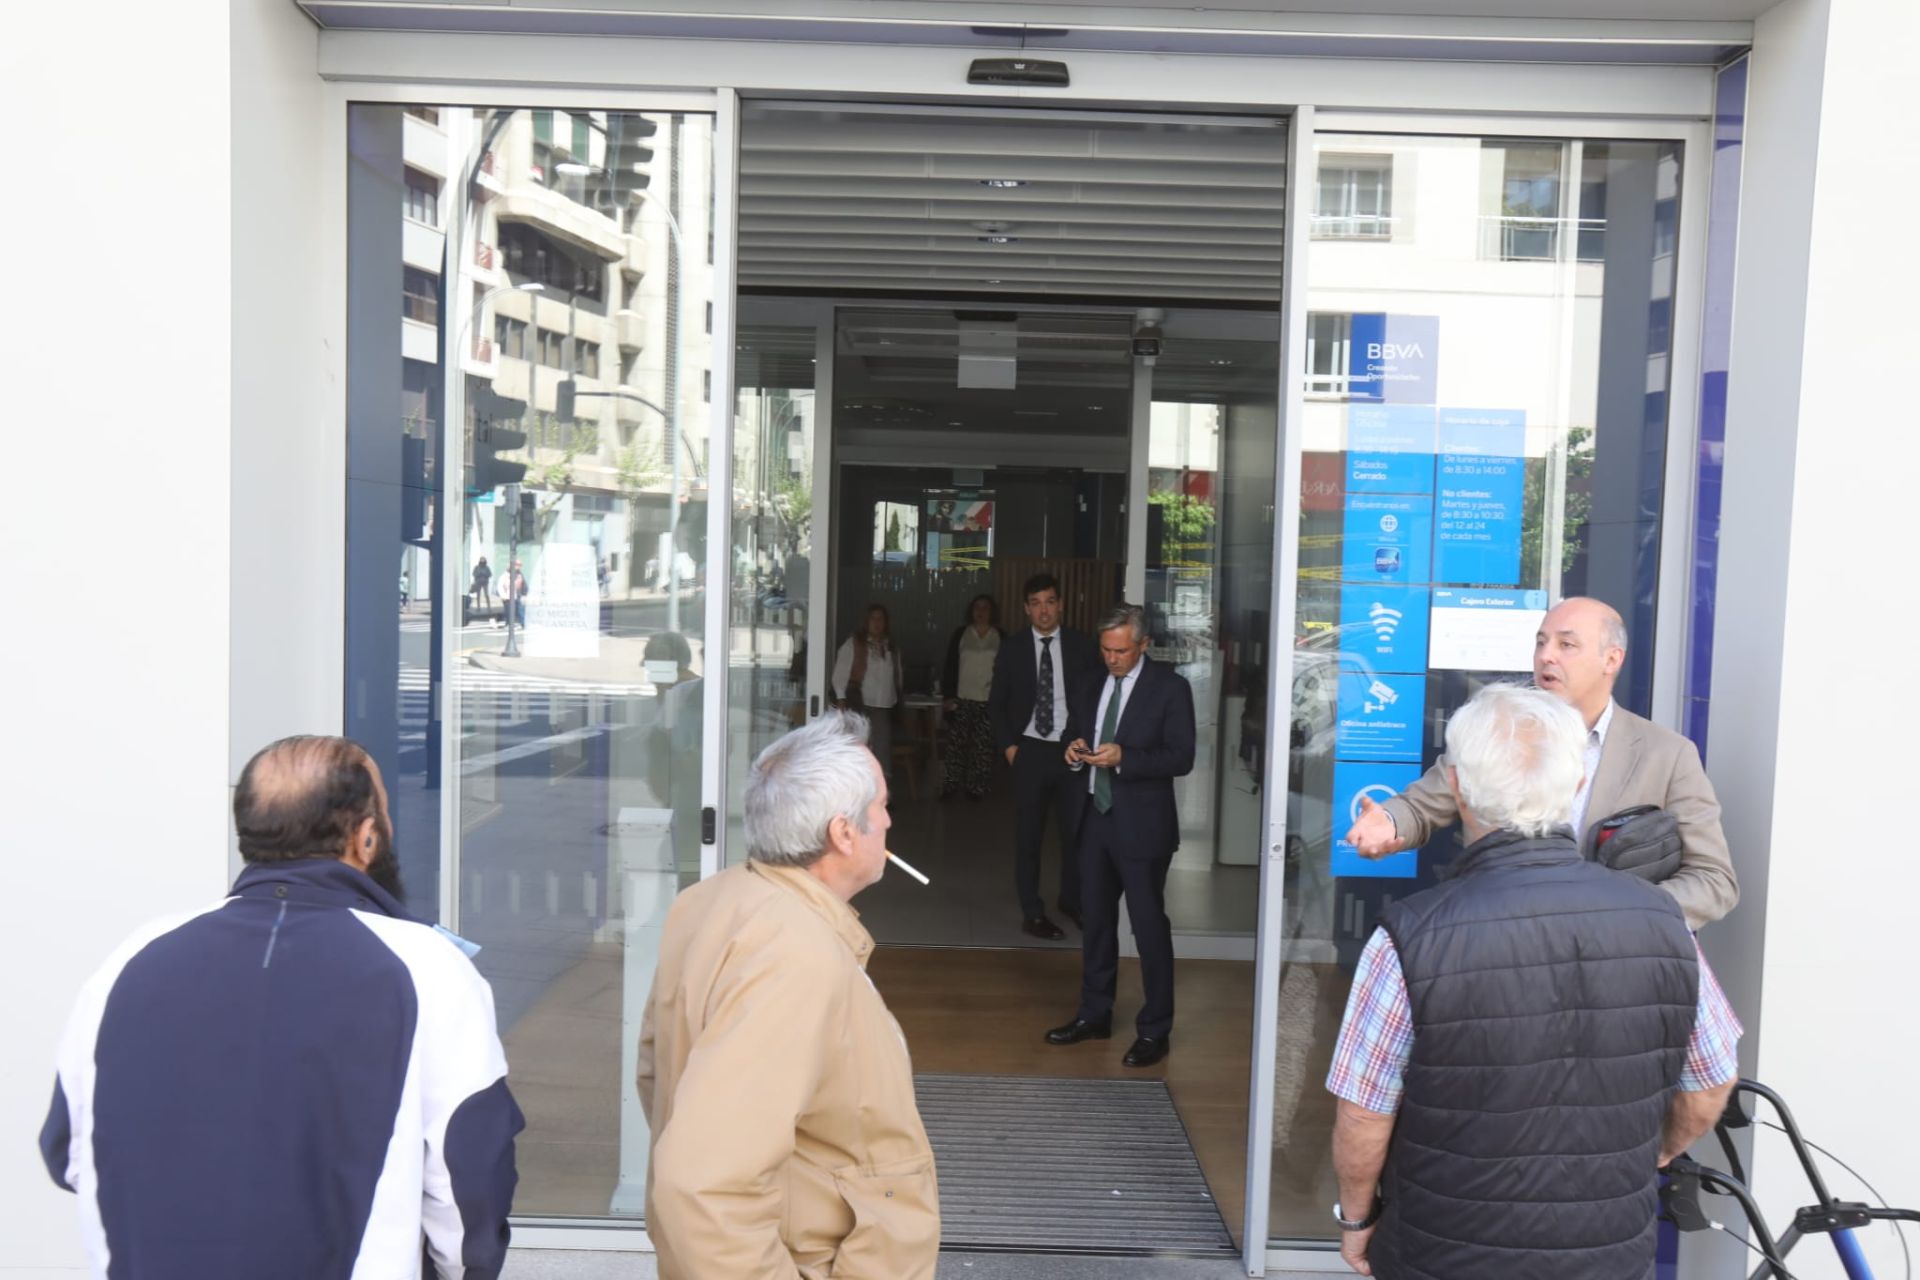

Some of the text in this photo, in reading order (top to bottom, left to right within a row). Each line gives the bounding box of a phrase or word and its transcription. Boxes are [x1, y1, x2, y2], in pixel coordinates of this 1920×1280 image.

[1367, 343, 1425, 360] BBVA
[1443, 466, 1454, 474] de
[1353, 471, 1387, 480] Cerrado
[1442, 489, 1455, 497] No
[1441, 500, 1471, 508] Martes
[1453, 511, 1473, 519] 8:30
[1480, 511, 1505, 519] 10:30
[1474, 522, 1486, 530] 24
[1452, 533, 1473, 541] cada
[1460, 597, 1515, 606] Cajero Exterior
